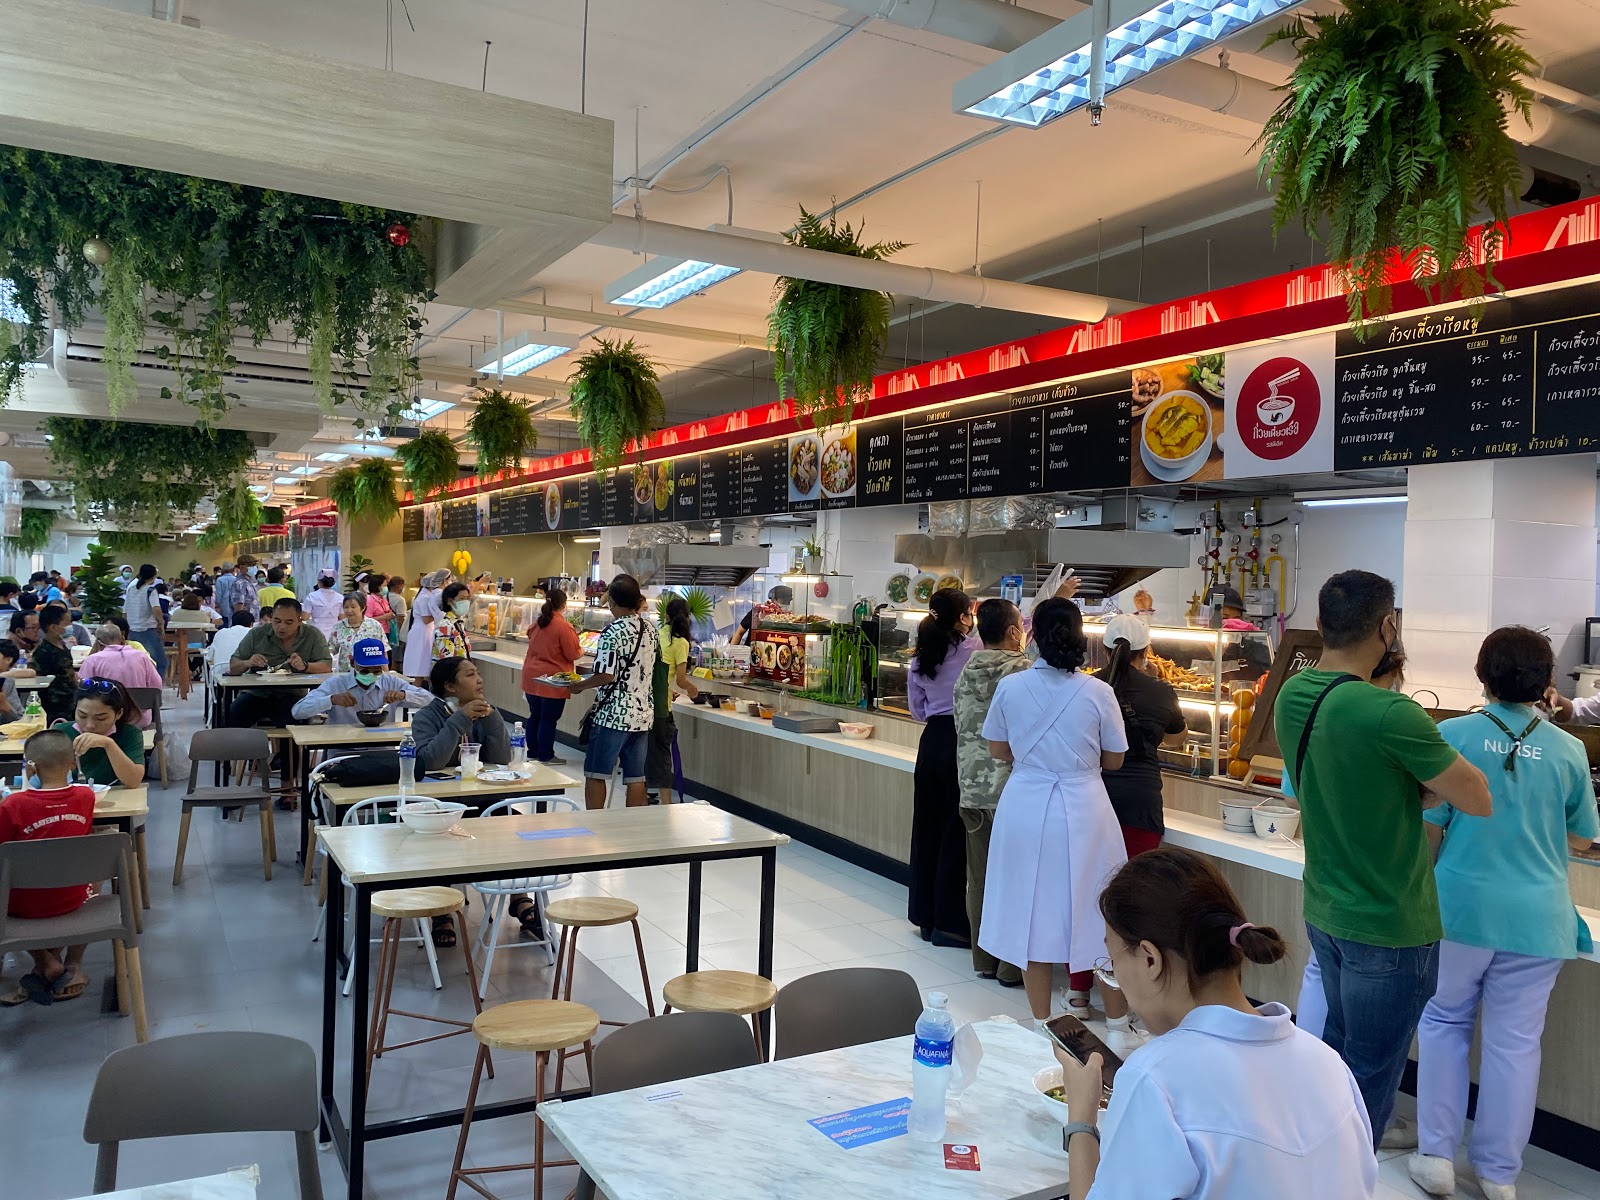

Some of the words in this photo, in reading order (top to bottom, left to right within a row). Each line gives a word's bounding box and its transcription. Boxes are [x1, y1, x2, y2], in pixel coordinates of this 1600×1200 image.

[1548, 329, 1600, 352] ก๋วยเตี๋ยวเ
[1392, 358, 1428, 379] ลูกชิ้นหมู
[1471, 356, 1491, 365] 35.-
[1502, 351, 1522, 360] 45.-
[1547, 355, 1600, 377] ก๋วยเตี๋ยวเ
[1392, 387, 1404, 400] หมู
[1470, 378, 1490, 387] 50.-
[1502, 374, 1522, 383] 60.-
[1470, 401, 1490, 410] 55.-
[1501, 398, 1521, 406] 65.-
[1470, 423, 1490, 431] 60.-
[1500, 420, 1520, 429] 70.-
[1451, 448, 1464, 457] 5.-
[1578, 437, 1598, 446] 10.-
[1484, 738, 1543, 760] NURSE
[23, 825, 34, 835] FC
[32, 814, 60, 829] BAYERN
[917, 1045, 949, 1059] AQUAFINA
